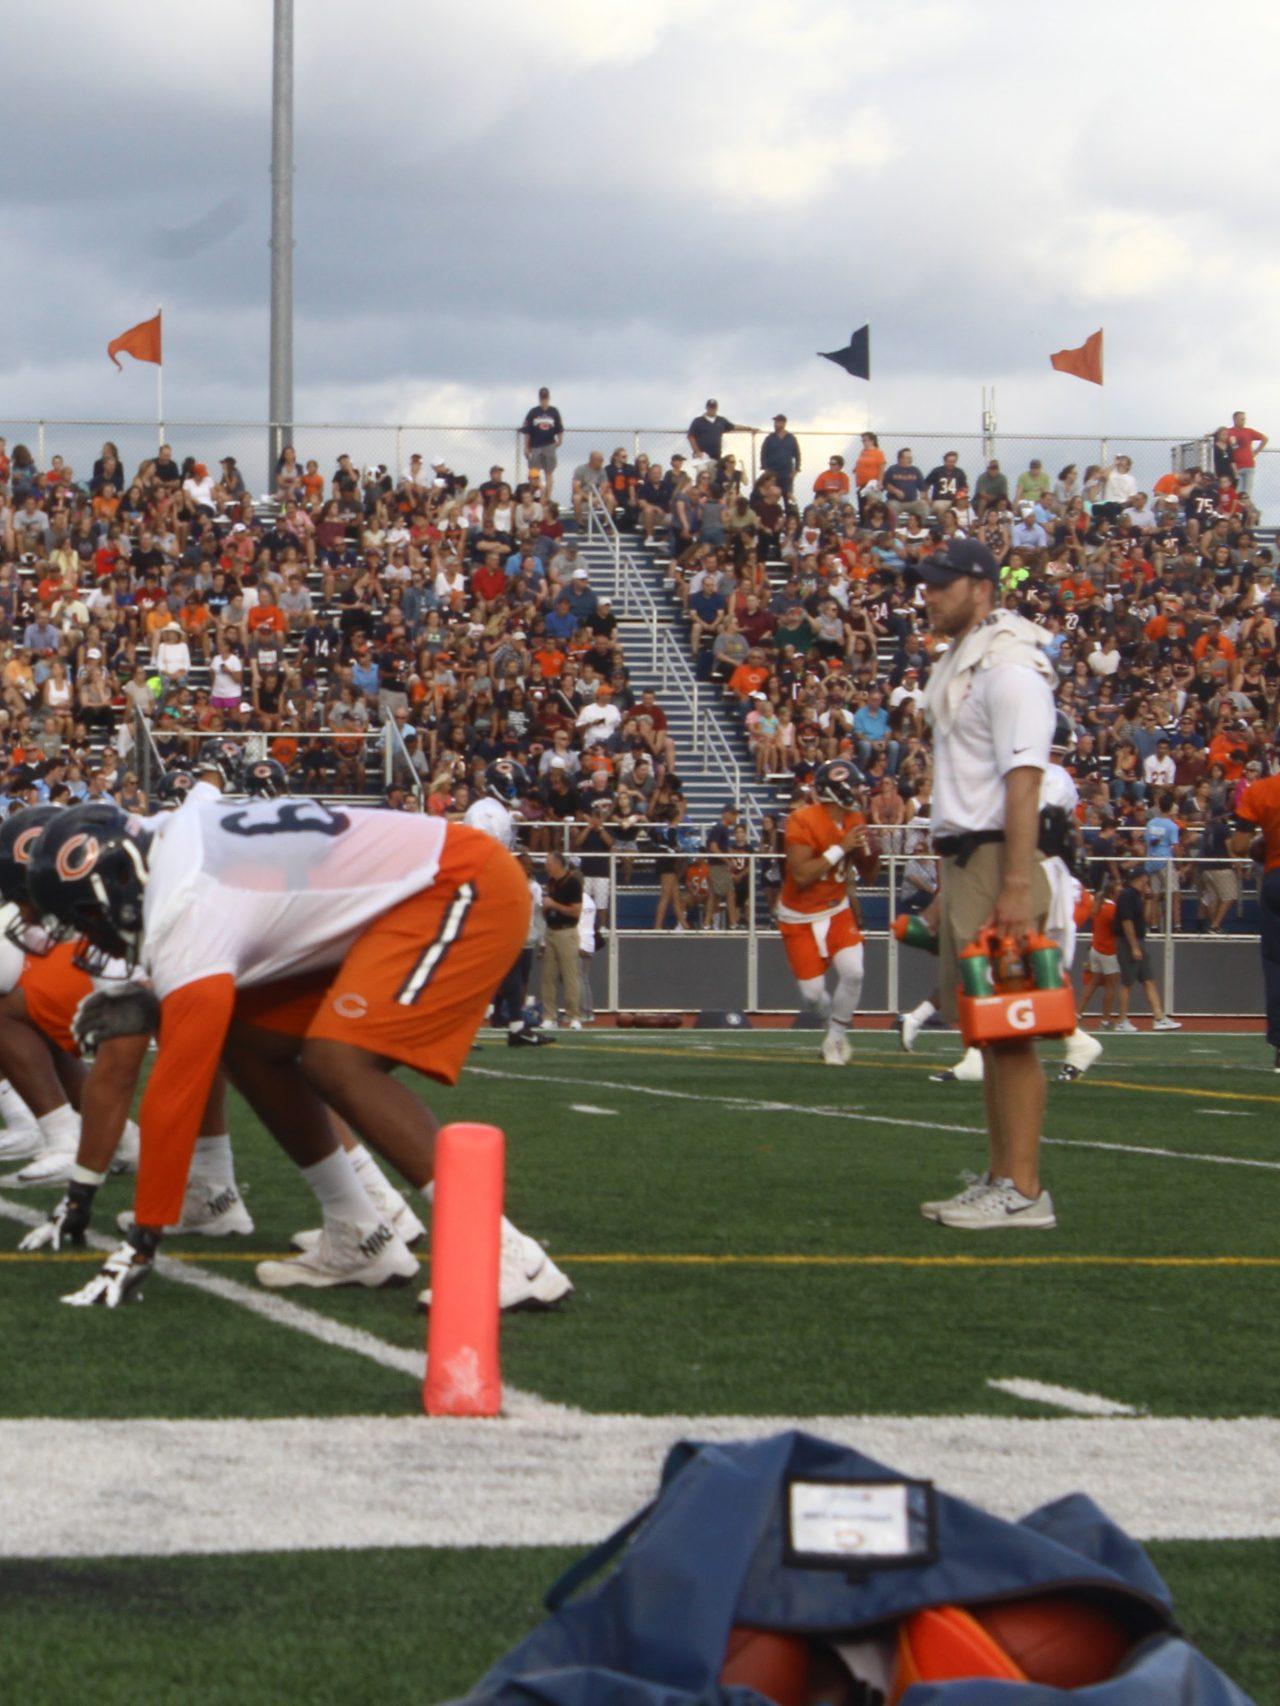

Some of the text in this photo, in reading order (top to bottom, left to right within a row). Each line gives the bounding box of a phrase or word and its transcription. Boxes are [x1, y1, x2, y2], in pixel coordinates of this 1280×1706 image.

[939, 477, 957, 494] 34
[1196, 498, 1214, 513] 75
[314, 638, 330, 656] 14
[1006, 998, 1036, 1030] G
